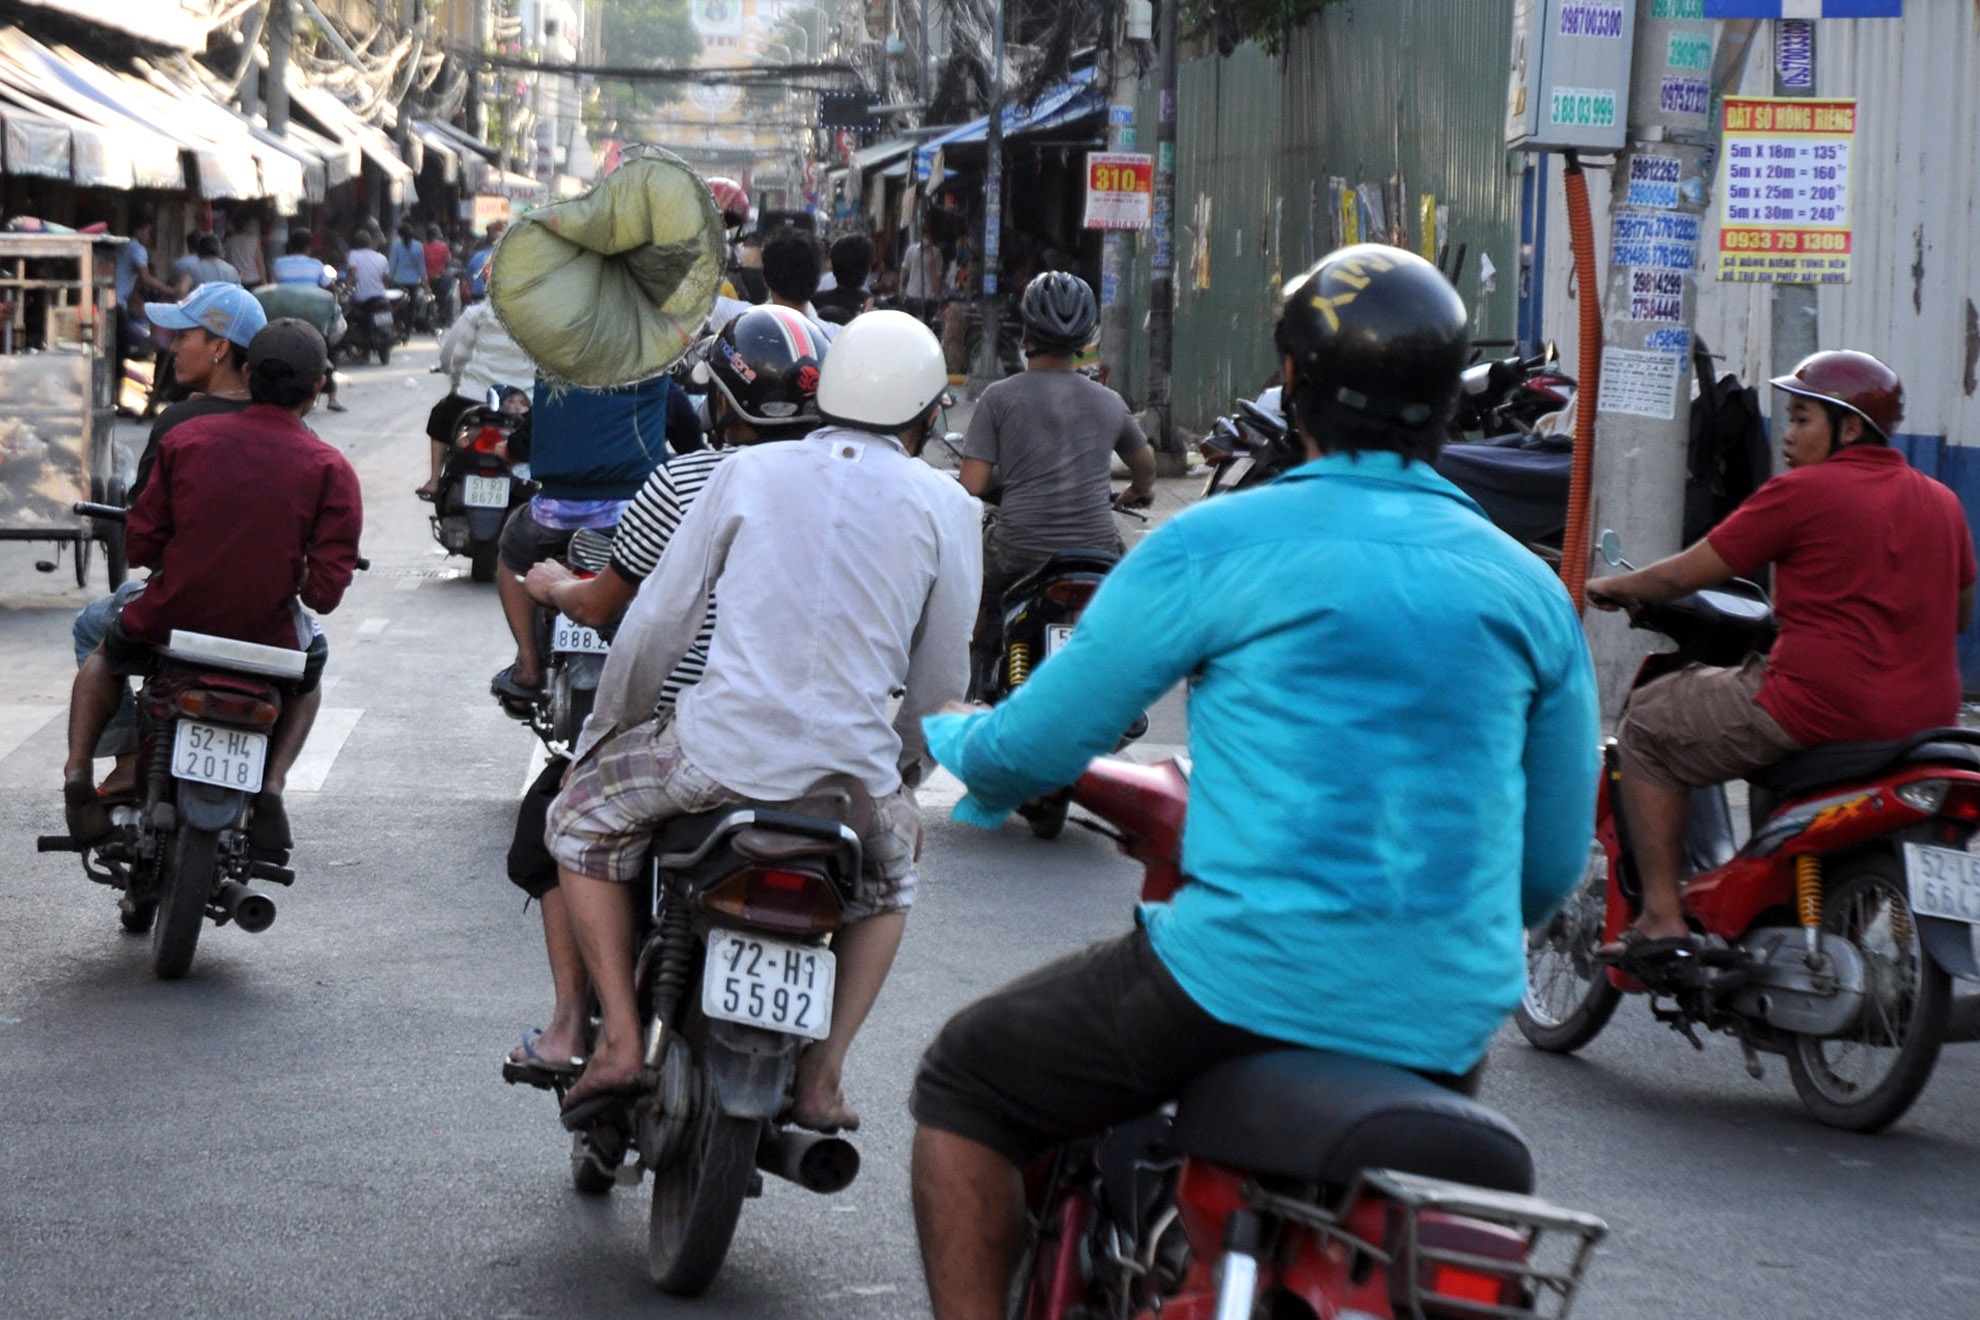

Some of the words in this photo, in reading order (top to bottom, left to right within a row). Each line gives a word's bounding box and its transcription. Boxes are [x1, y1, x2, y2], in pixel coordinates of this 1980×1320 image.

[1731, 144, 1752, 158] 5m
[1769, 145, 1796, 159] 18m
[1096, 168, 1136, 193] 310
[1730, 164, 1751, 178] 5m
[1766, 165, 1795, 179] 20m
[1730, 184, 1750, 198] 5m
[1765, 185, 1794, 200] 25m
[1729, 205, 1750, 219] 5m
[1764, 206, 1794, 220] 30m
[1726, 231, 1772, 249] 0933
[1776, 232, 1797, 249] 79
[1803, 233, 1846, 250] 1308
[190, 725, 250, 759] 52-H4
[186, 752, 249, 784] 2018
[730, 938, 815, 989] 72-H1
[723, 977, 812, 1029] 5592
